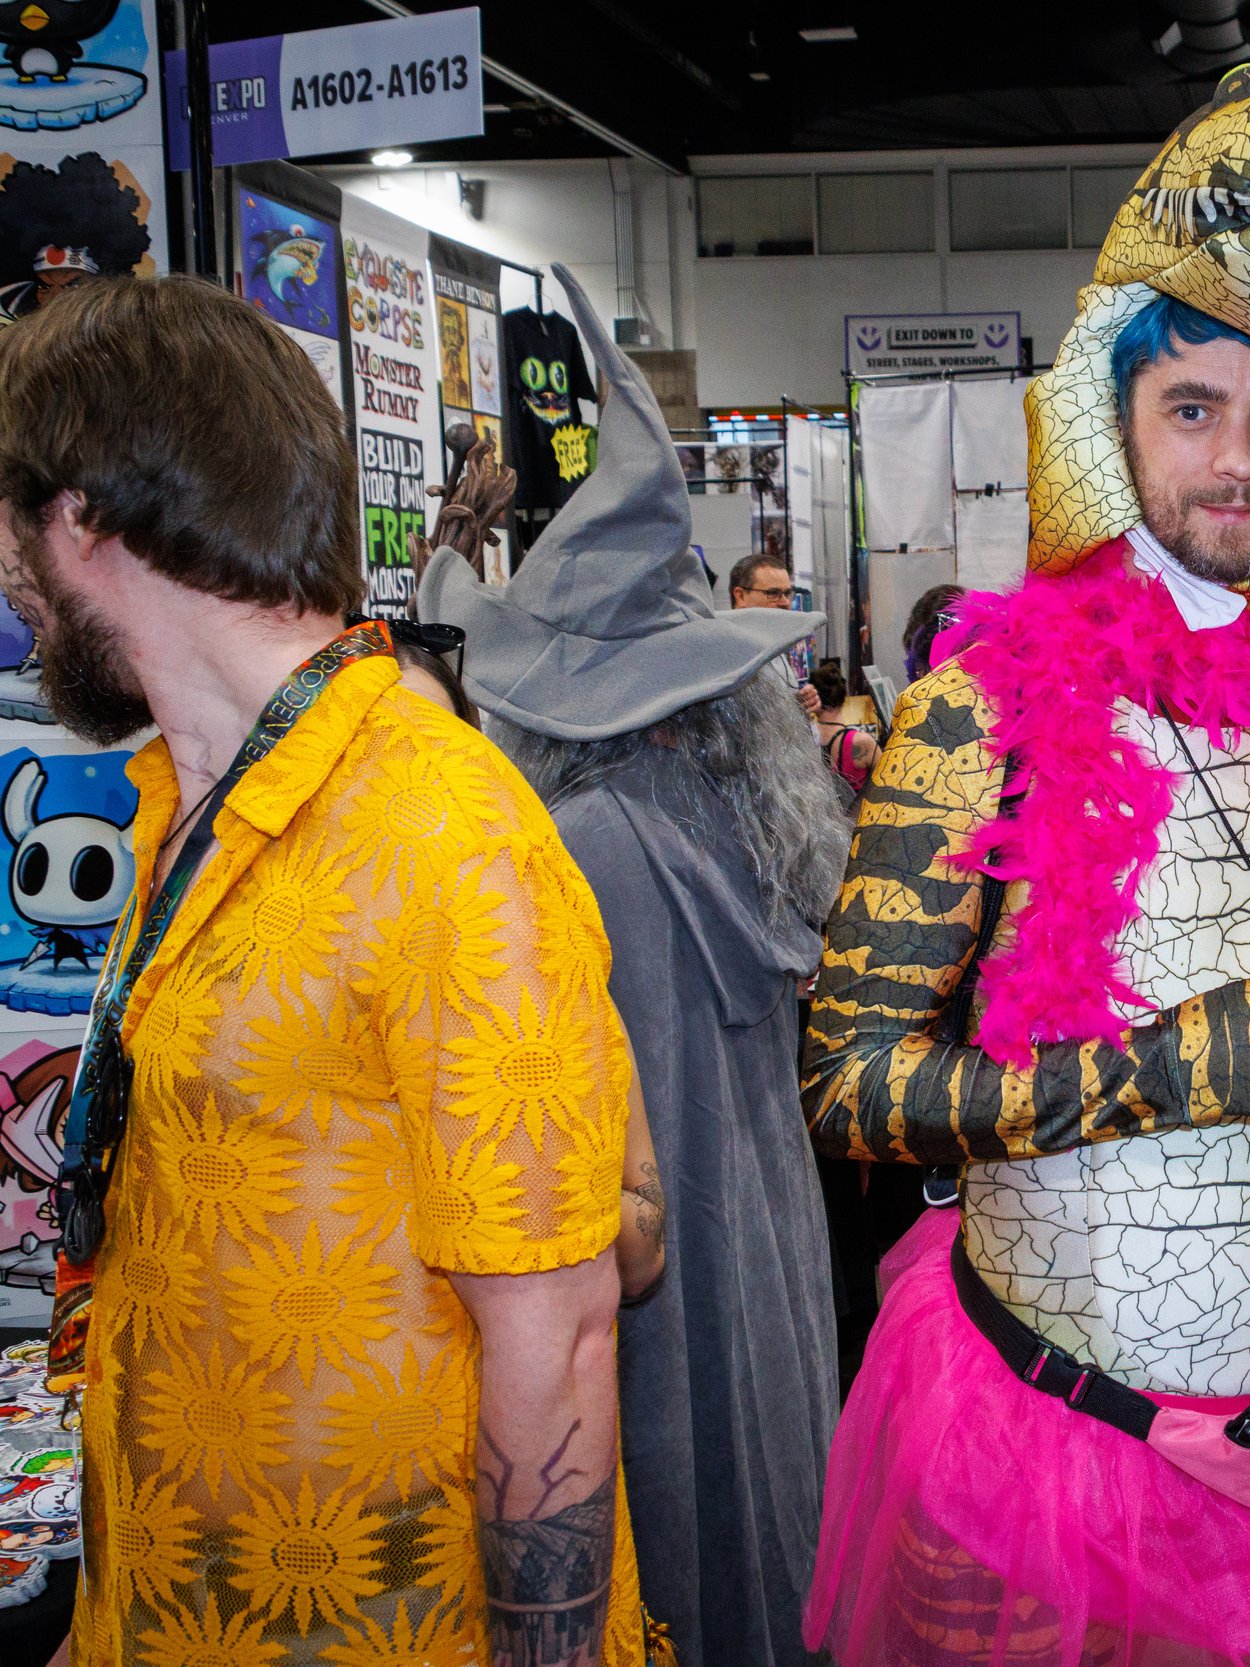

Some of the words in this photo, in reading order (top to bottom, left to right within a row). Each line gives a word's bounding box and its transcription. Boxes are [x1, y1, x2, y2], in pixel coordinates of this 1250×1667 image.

[291, 54, 469, 112] A1602-A1613
[348, 285, 424, 350] CORPSE
[895, 329, 919, 341] EXIT
[921, 329, 957, 341] DOWN
[960, 328, 974, 340] TO
[352, 340, 425, 392] MONSTER
[360, 377, 419, 423] RUMMY
[361, 433, 422, 476] BUILD
[361, 471, 397, 508] YOUR
[399, 475, 424, 511] OWN
